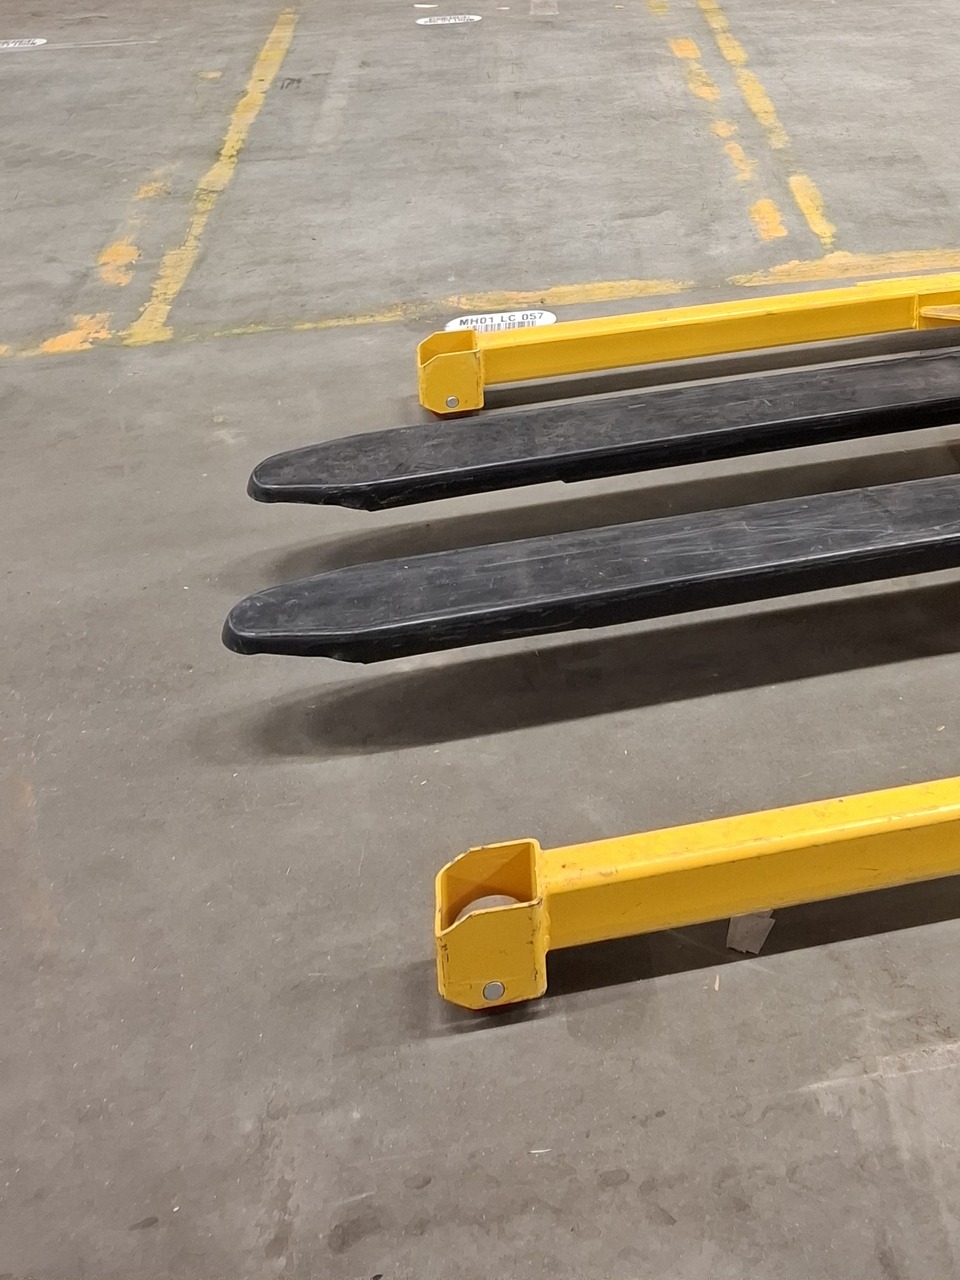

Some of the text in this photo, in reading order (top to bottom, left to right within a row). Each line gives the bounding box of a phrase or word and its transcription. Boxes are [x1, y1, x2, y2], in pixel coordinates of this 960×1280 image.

[459, 312, 544, 326] MH01 LC 057
